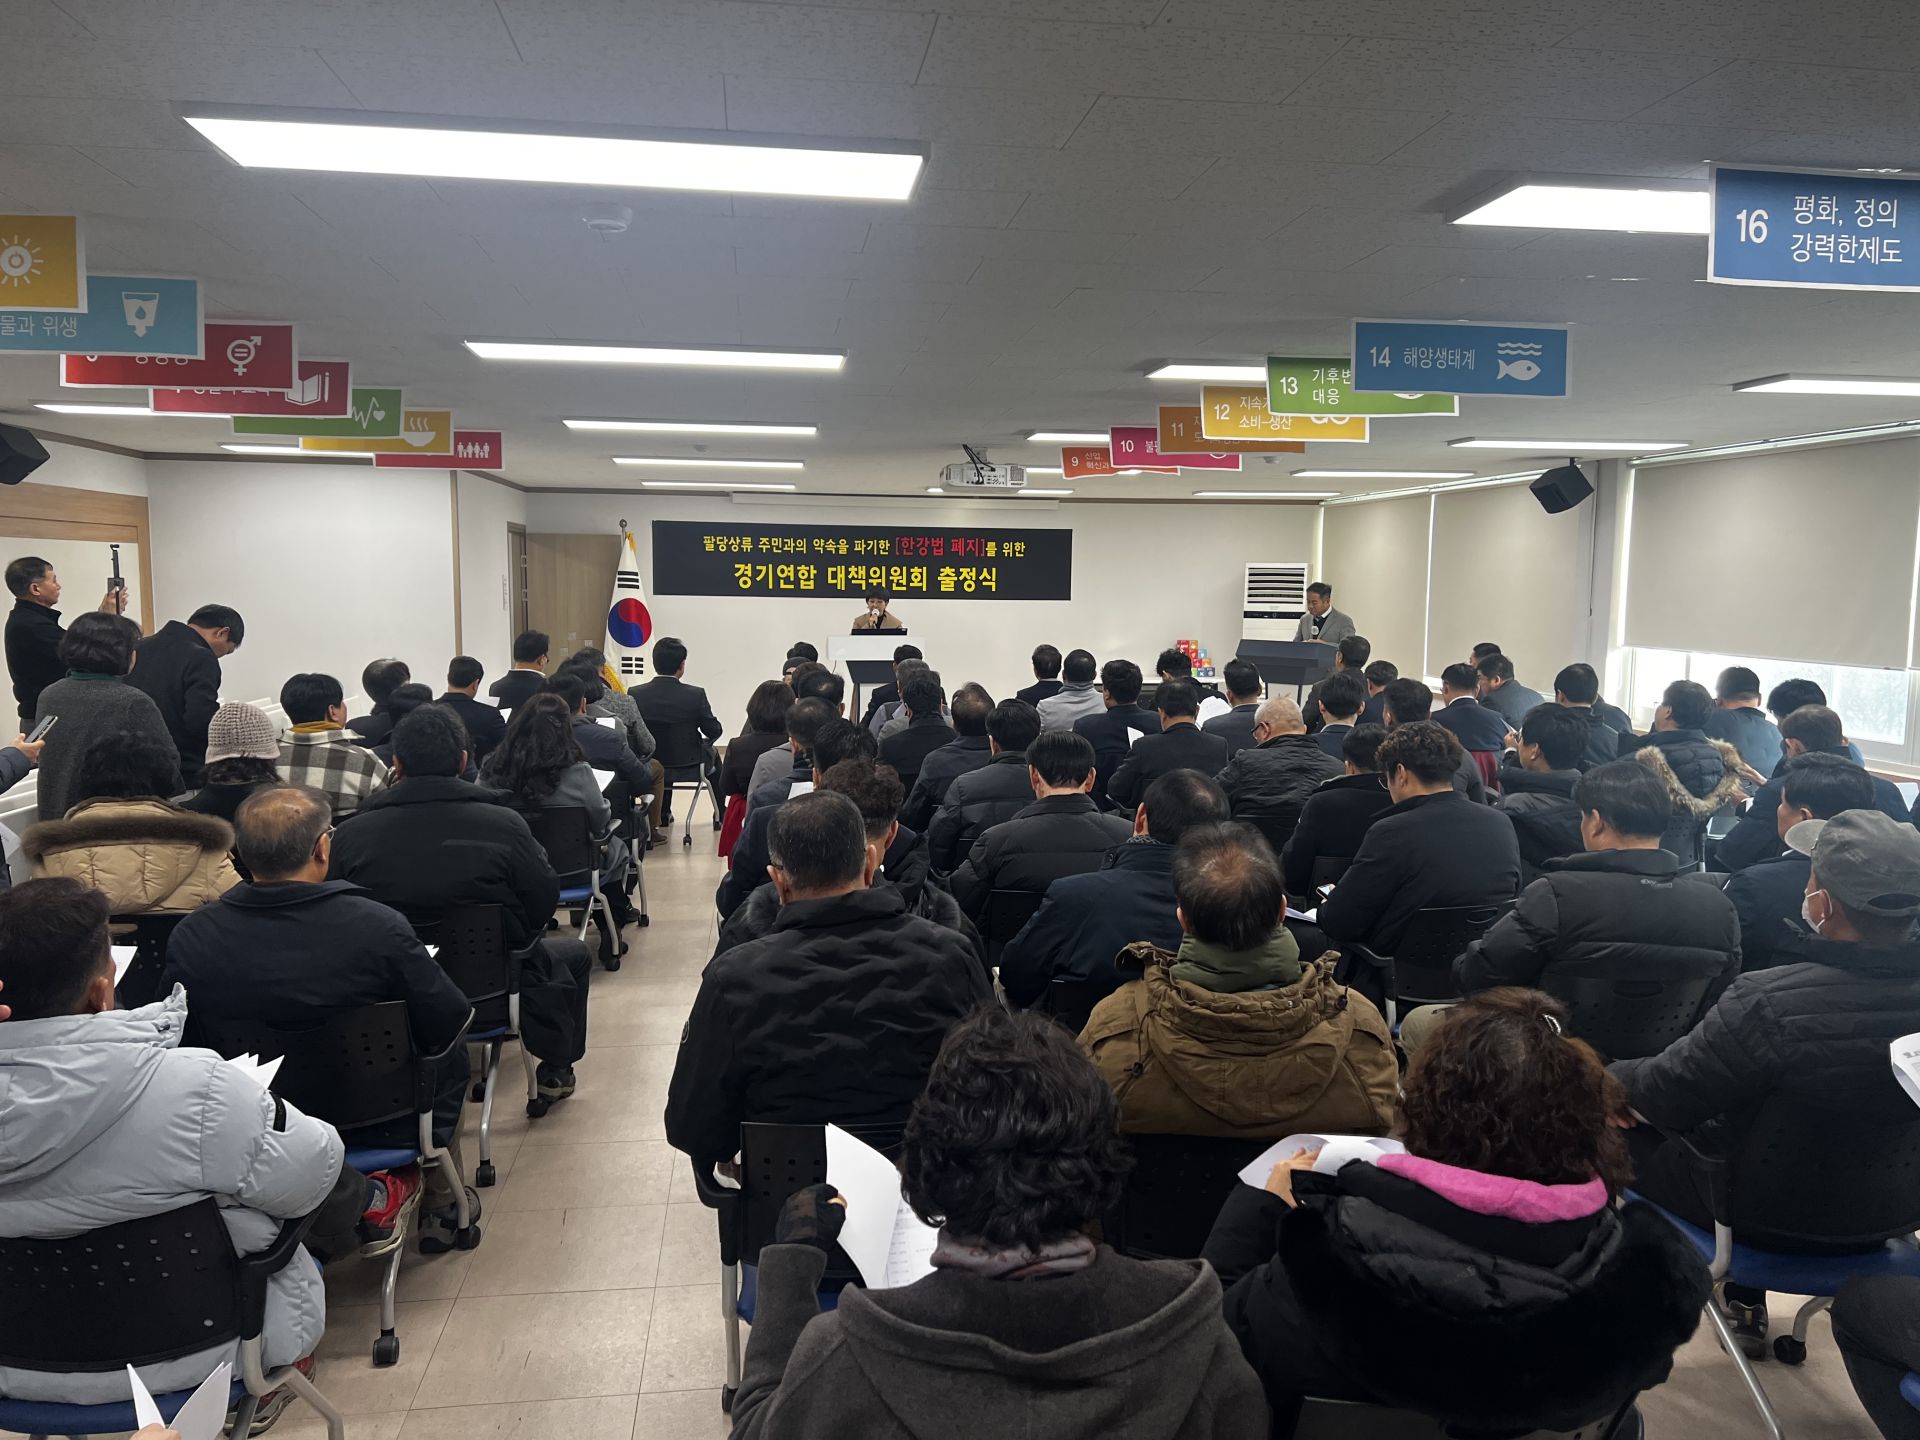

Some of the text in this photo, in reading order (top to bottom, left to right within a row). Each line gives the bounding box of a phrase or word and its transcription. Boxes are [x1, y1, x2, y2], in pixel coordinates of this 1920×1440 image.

[1793, 194, 1898, 229] 평화, 정의
[1736, 209, 1769, 244] 16
[1790, 232, 1903, 266] 강력한제도
[0, 315, 78, 338] 물과 위생
[1369, 346, 1391, 368] 14
[1403, 346, 1476, 370] 해양생태계
[1279, 376, 1299, 396] 13
[1312, 367, 1352, 385] 기후변
[1312, 388, 1341, 406] 대응
[1213, 403, 1231, 421] 12
[1170, 422, 1184, 437] 11
[1238, 415, 1293, 431] 소비-생산
[1120, 440, 1135, 453] 10
[1071, 456, 1080, 467] 9
[703, 535, 1026, 558] 팔당상류 주민과의 약속을 파기한 [한강법 폐지]를 위한
[734, 563, 998, 593] 경기연합 대책위원회 출정식
